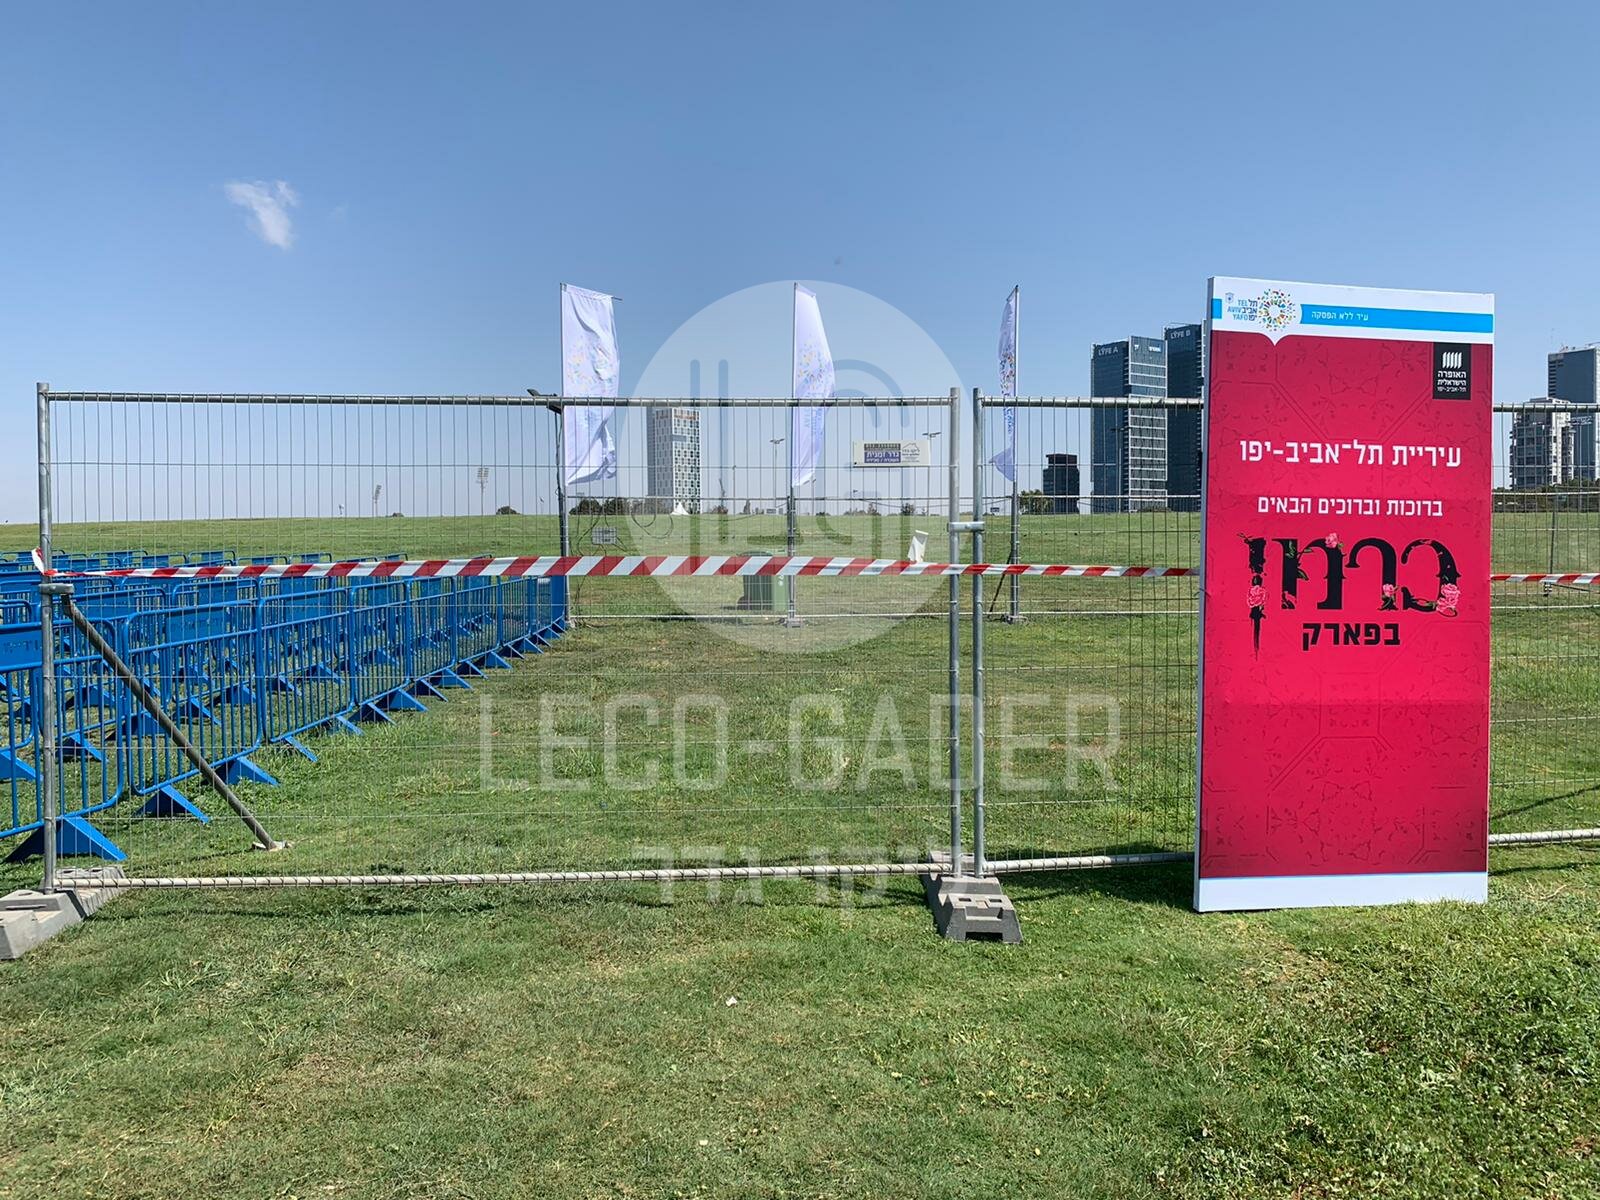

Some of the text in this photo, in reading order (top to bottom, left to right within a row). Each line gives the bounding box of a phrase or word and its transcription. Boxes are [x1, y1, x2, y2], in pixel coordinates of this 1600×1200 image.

[1248, 299, 1257, 307] תל
[1311, 310, 1369, 321] עיר ללא הפסקה
[1437, 370, 1467, 378] האופרה
[1392, 444, 1461, 468] עיריית
[1257, 496, 1443, 517] ברוכות וברוכים הבאים
[1242, 534, 1462, 661] כרמן
[1303, 622, 1401, 651] בפארק
